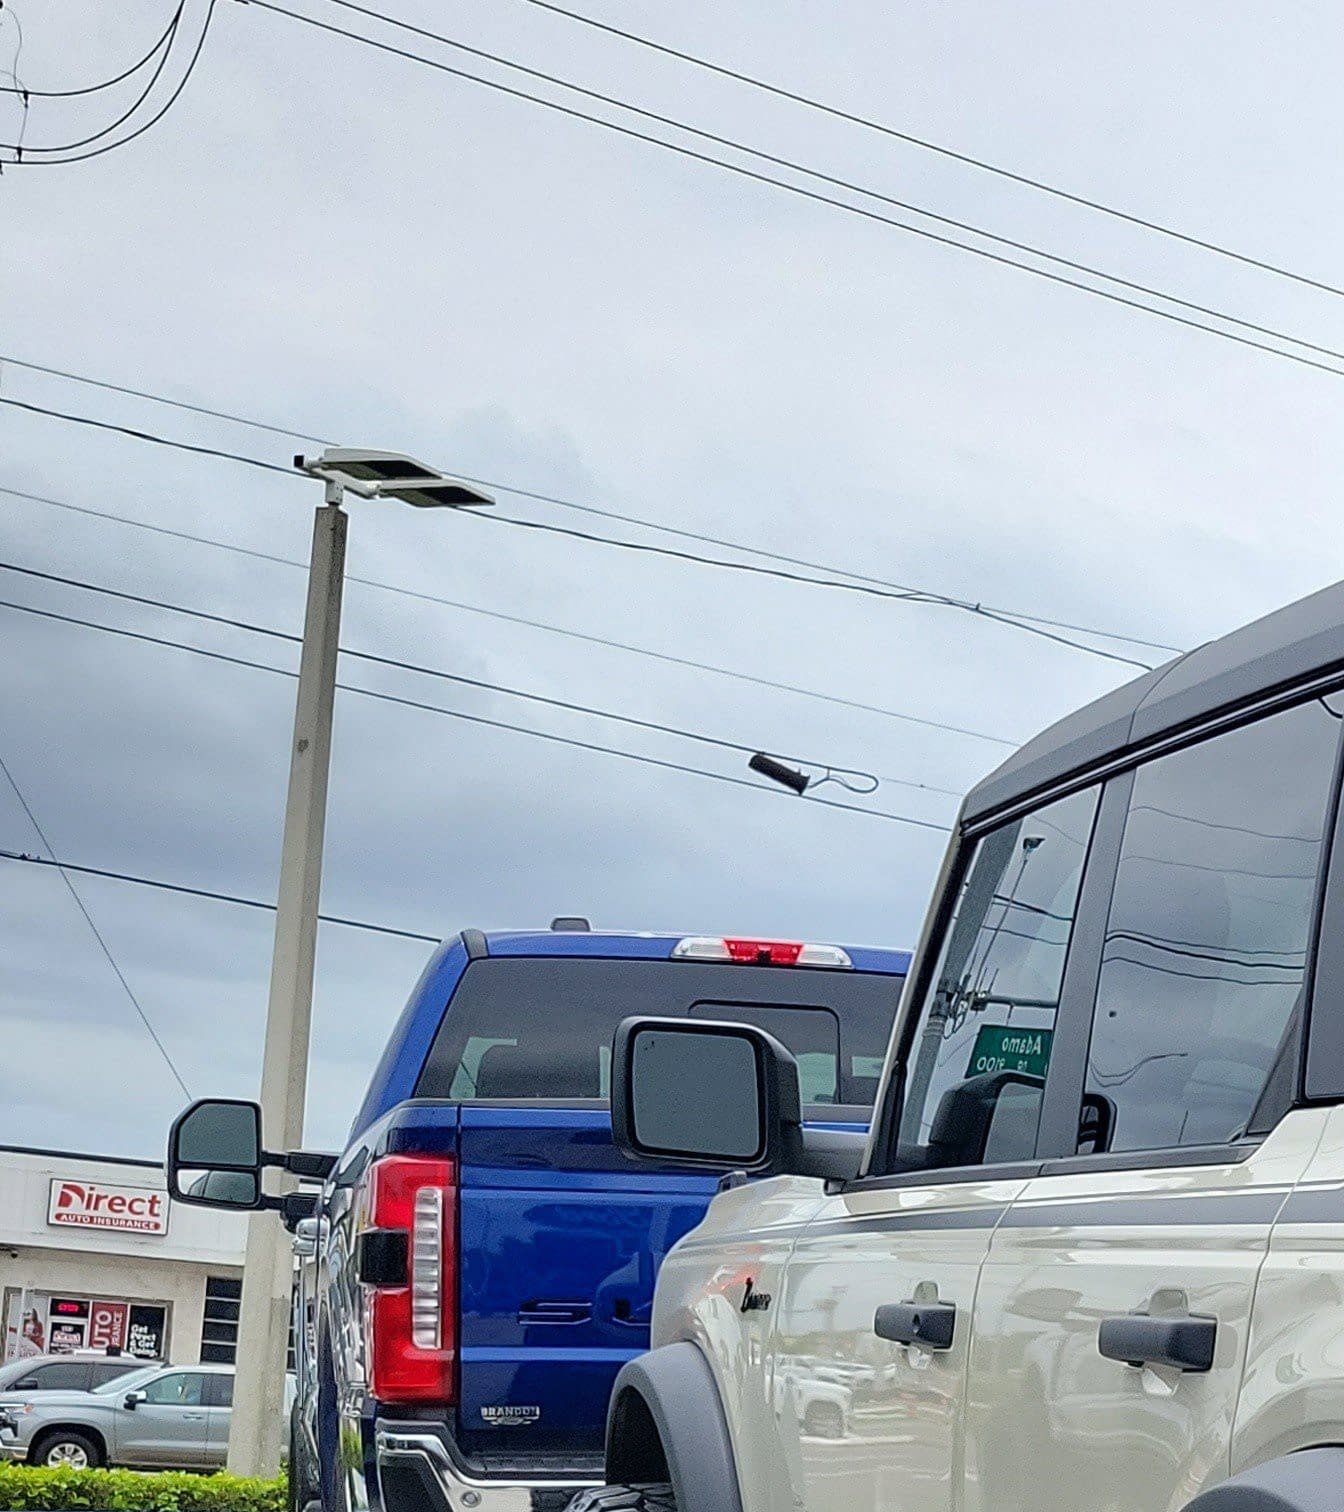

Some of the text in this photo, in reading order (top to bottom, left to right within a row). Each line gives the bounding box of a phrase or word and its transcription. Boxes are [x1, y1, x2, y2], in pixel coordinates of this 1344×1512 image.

[58, 1184, 161, 1217] Direct
[61, 1213, 156, 1230] AUTO INSURANCE
[93, 1311, 113, 1348] UTO
